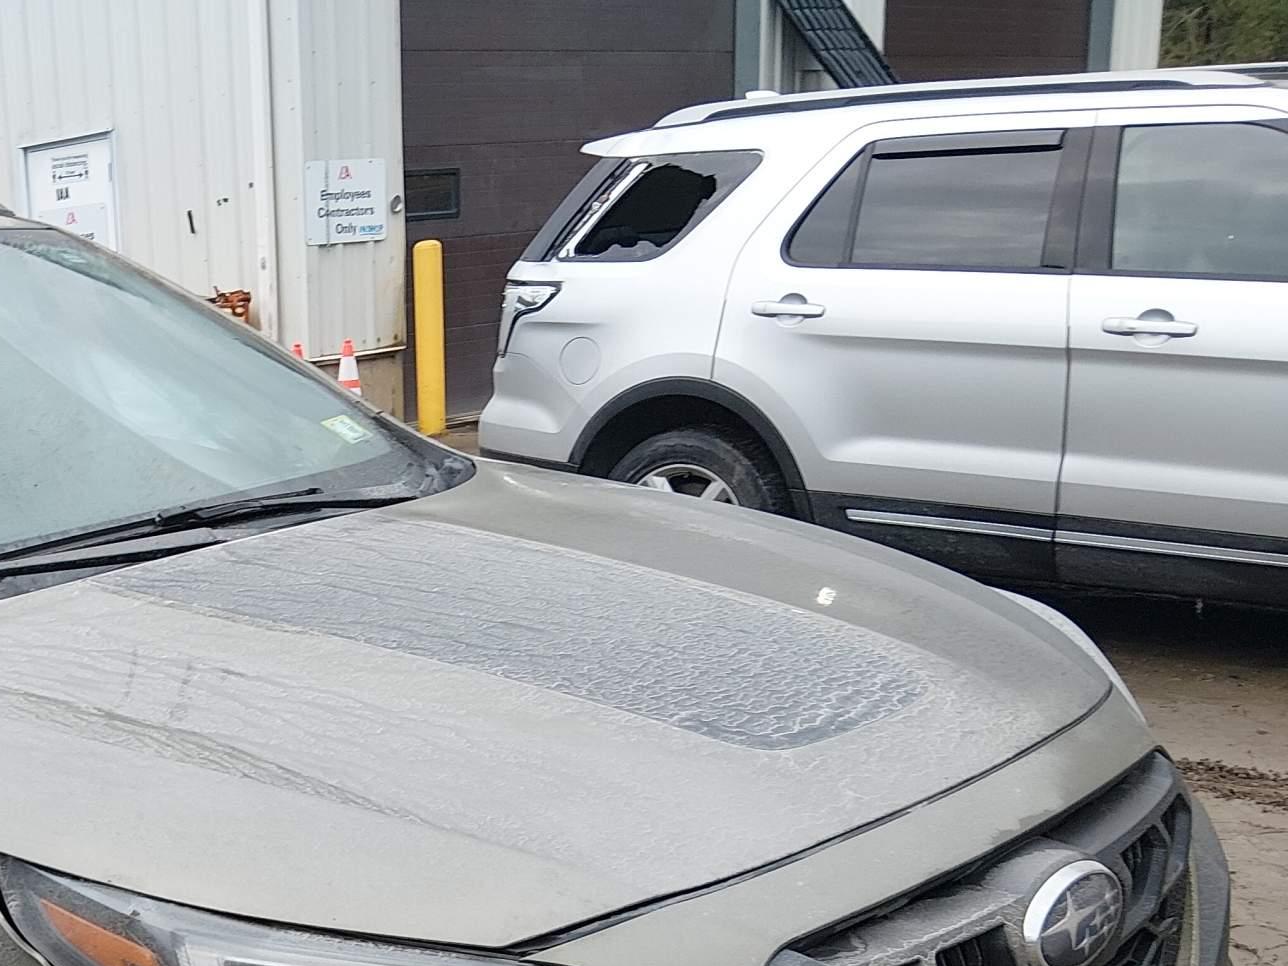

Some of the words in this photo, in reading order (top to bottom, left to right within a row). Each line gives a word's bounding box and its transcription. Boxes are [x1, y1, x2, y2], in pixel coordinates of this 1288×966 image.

[320, 188, 372, 202] Employees
[317, 206, 374, 218] Contractors
[335, 222, 357, 236] Only
